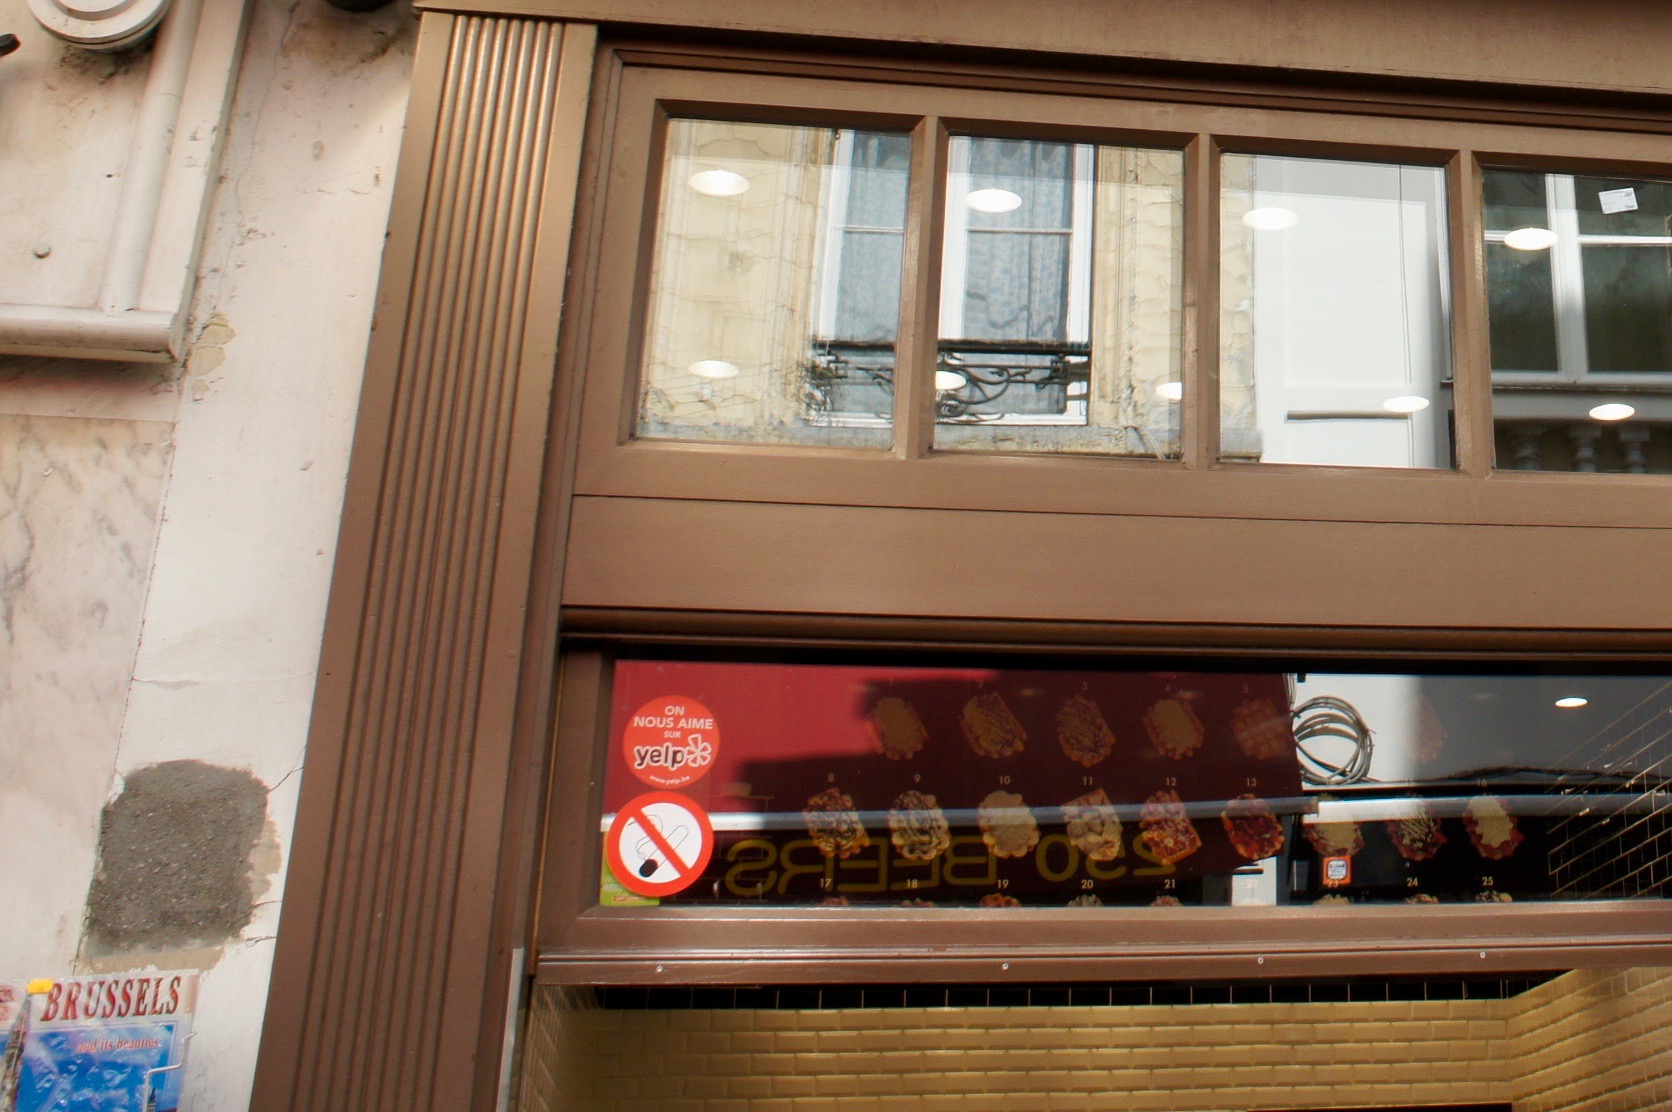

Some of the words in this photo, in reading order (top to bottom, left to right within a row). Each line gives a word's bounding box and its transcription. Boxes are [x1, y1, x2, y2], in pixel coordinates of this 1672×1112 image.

[664, 705, 685, 716] ON
[633, 716, 674, 729] NOUS
[677, 717, 714, 730] AIME
[663, 730, 682, 739] SUR
[634, 742, 685, 771] yelp
[913, 773, 921, 784] 9
[999, 774, 1011, 785] 10
[1082, 775, 1094, 786] 11
[1165, 776, 1177, 787] 12
[1246, 777, 1257, 787] 13
[819, 877, 832, 888] 17
[906, 878, 918, 889] 18
[997, 878, 1009, 889] 19
[1081, 878, 1094, 889] 20
[1163, 878, 1176, 889] 21
[1406, 877, 1419, 887] 24
[1481, 876, 1494, 887] 25
[40, 975, 182, 1022] BRUSSELS
[76, 1041, 97, 1053] and
[100, 1038, 113, 1050] its
[116, 1037, 159, 1051] beauties
